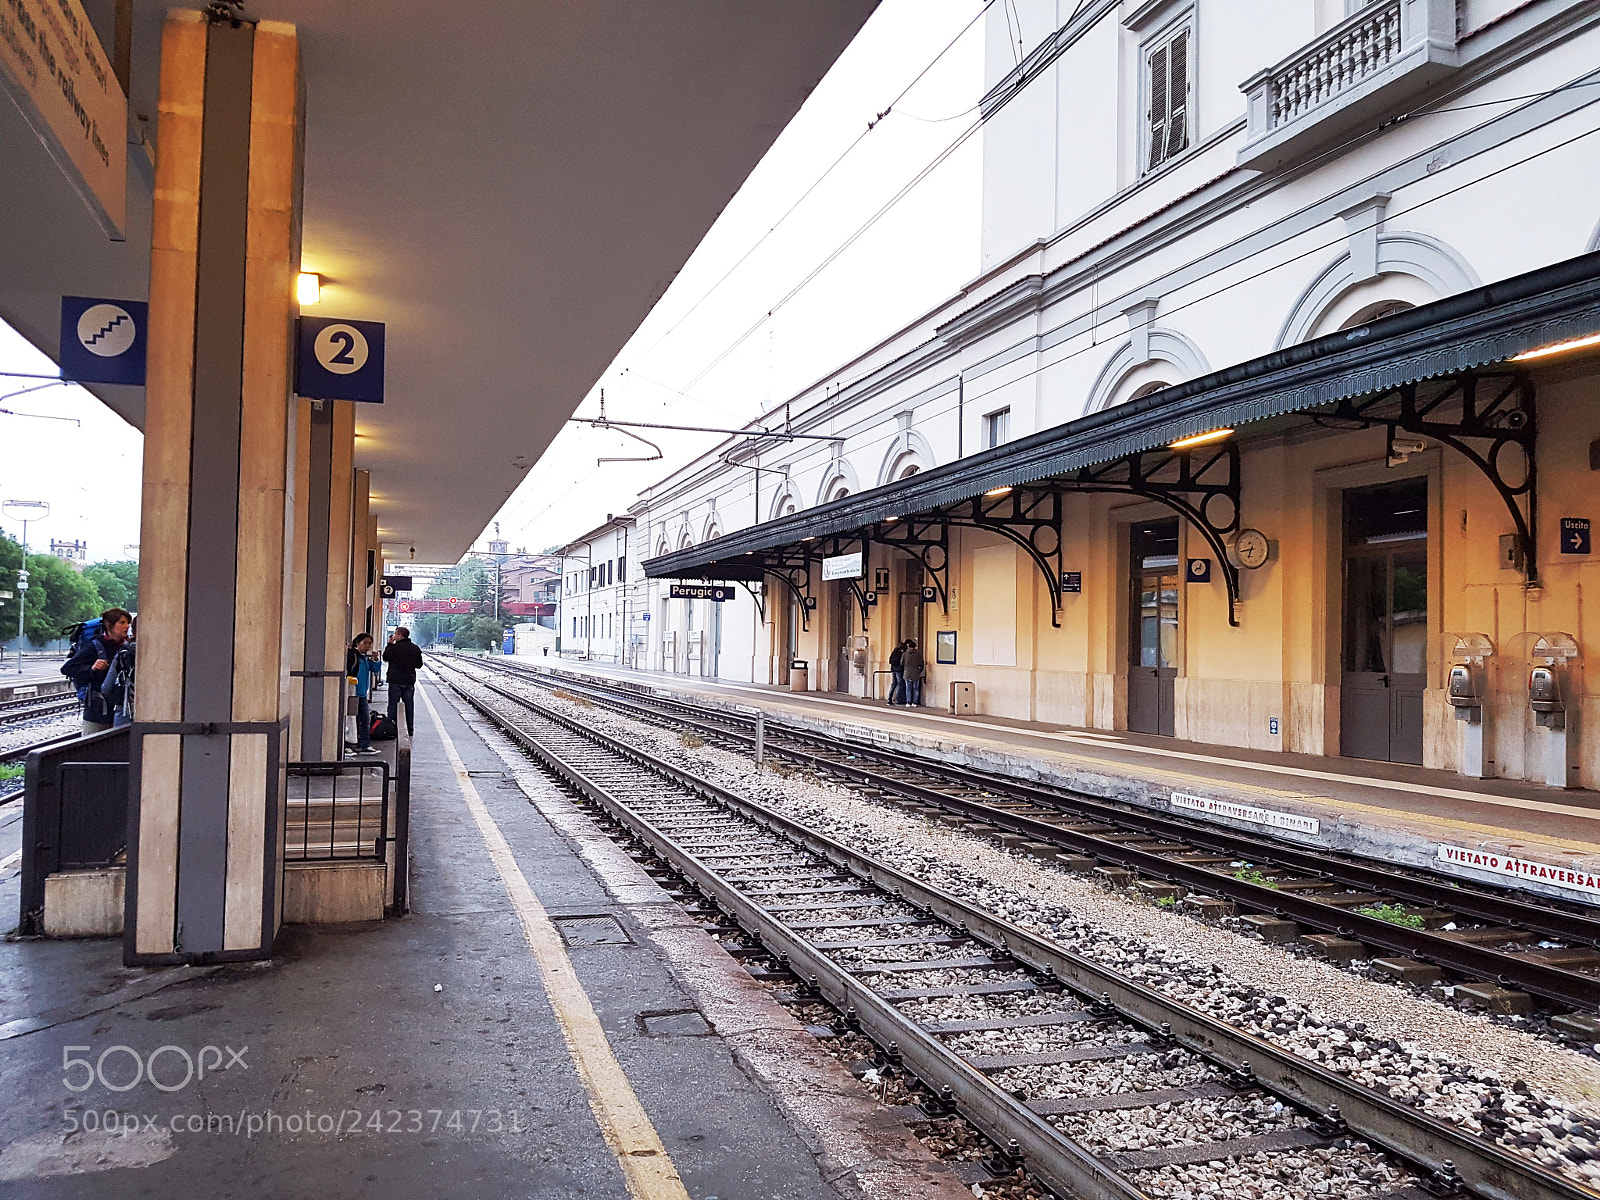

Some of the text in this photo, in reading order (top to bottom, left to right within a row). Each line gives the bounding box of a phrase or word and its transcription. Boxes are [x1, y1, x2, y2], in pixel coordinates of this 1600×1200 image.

[39, 29, 56, 77] the
[58, 66, 91, 140] railway
[92, 118, 110, 168] lines
[328, 330, 355, 365] 2
[1565, 520, 1588, 529] Uscita
[1175, 795, 1205, 808] VIETATO
[1208, 801, 1269, 823] ATTRAVERSARE
[1280, 817, 1313, 830] BINARI
[1446, 848, 1499, 868] VIETATO
